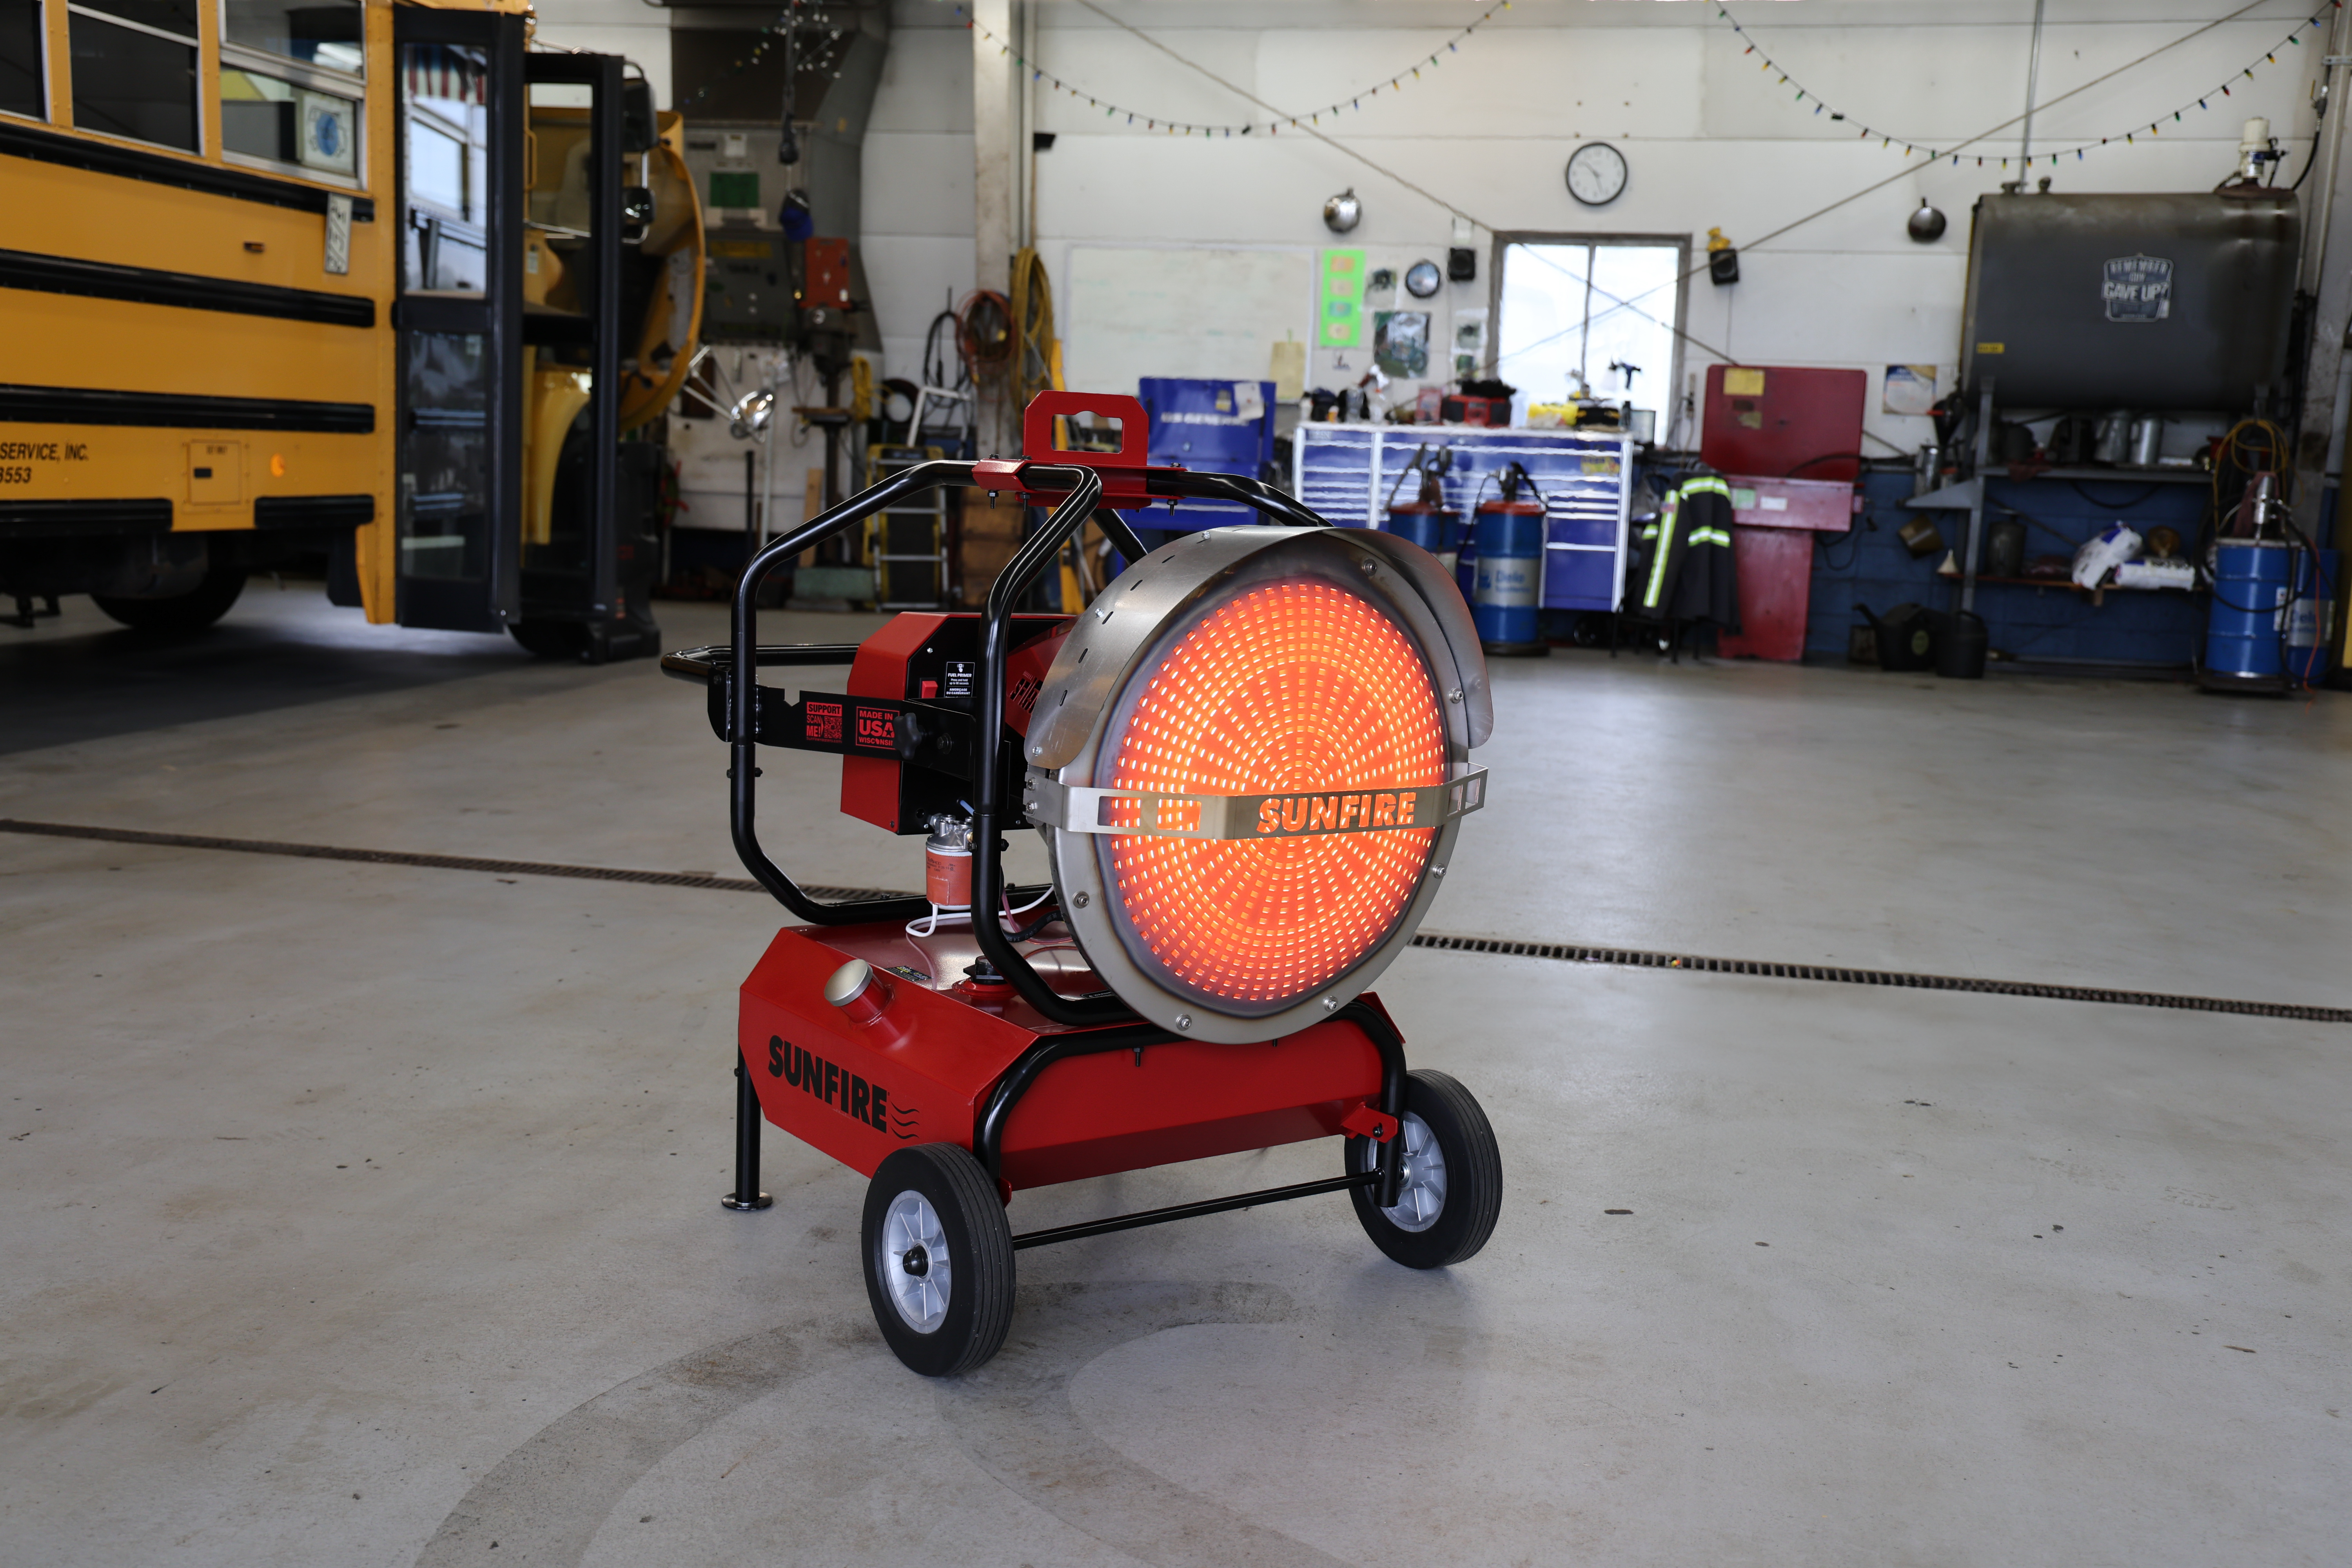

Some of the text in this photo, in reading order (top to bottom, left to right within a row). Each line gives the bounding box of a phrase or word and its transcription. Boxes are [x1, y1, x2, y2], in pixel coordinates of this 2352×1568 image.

[2103, 281, 2139, 301] GAVE
[0, 442, 89, 464] SERVICE, INC.
[809, 704, 840, 714] SUPPORT
[860, 710, 883, 719] MADE
[807, 715, 821, 724] SCAN
[859, 719, 895, 738] USA
[807, 725, 821, 737] ME!
[1256, 792, 1416, 833] SUNFIRE
[768, 1035, 887, 1134] SUNFIRE
